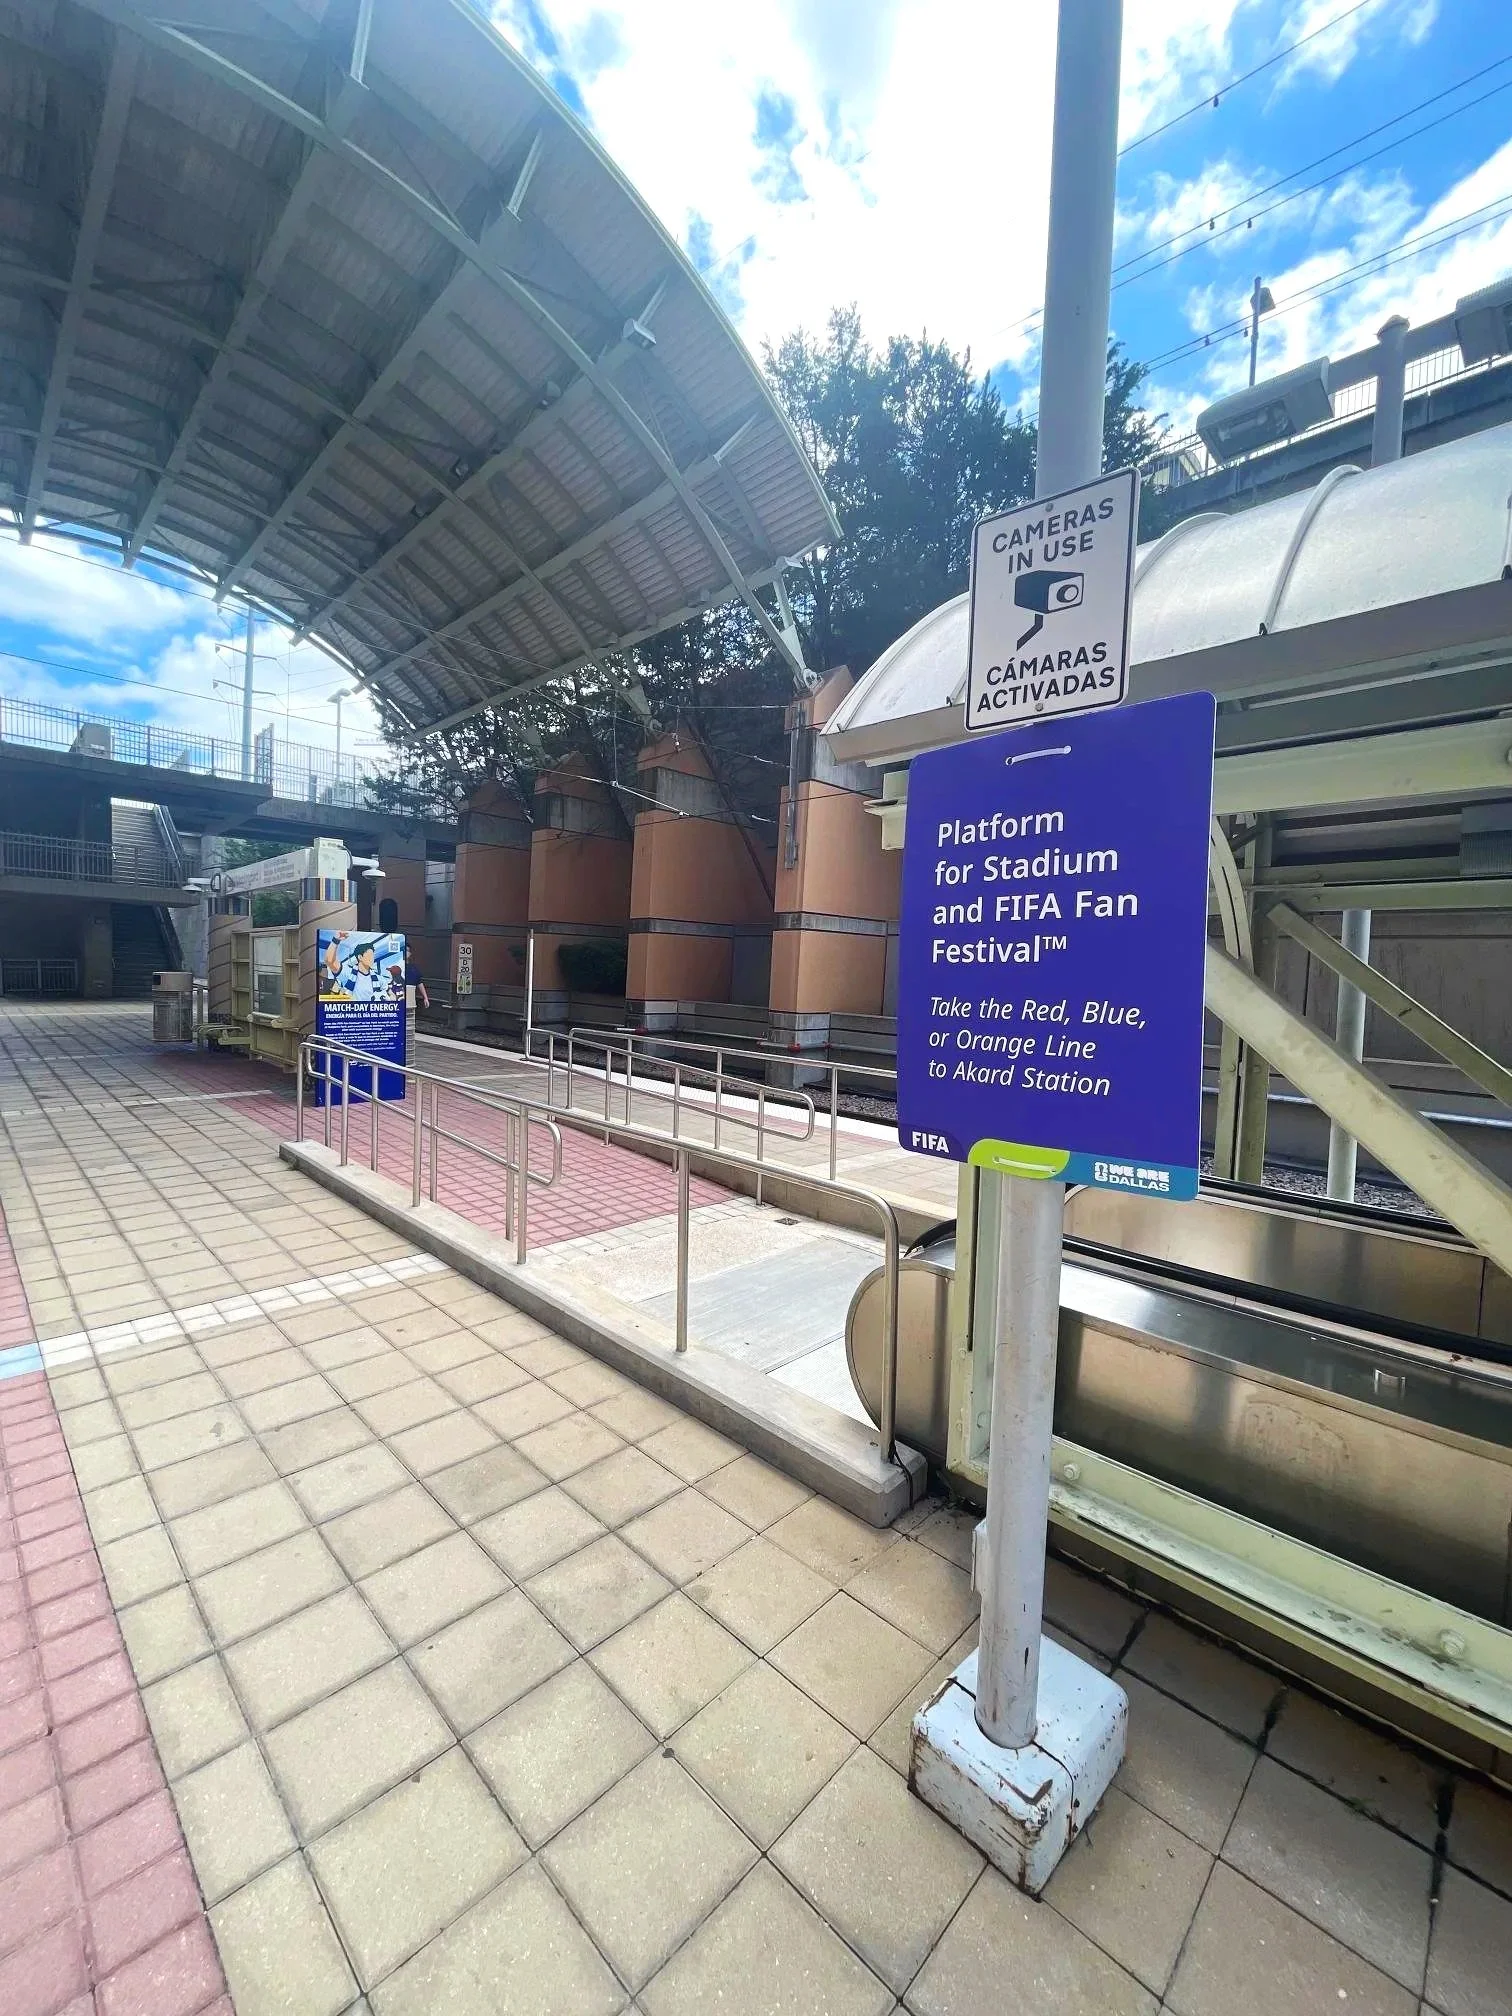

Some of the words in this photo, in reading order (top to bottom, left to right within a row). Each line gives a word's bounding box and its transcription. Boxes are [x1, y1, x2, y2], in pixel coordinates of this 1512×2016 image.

[992, 497, 1114, 553] CAMERAS
[1008, 548, 1033, 574] IN
[1043, 529, 1094, 563] USE
[986, 641, 1107, 686] CÁMARAS
[977, 666, 1116, 713] ACTIVADAS
[938, 810, 1064, 847] Platform
[935, 860, 974, 886] for
[983, 847, 1118, 882] Stadium
[933, 896, 983, 925] and
[995, 892, 1062, 922] FIFA
[1076, 890, 1138, 918] Fan
[932, 935, 1067, 964] Festival™
[930, 997, 972, 1018] Take
[979, 997, 1013, 1020] the
[1021, 999, 1070, 1026] Red,
[1081, 1000, 1147, 1030] Blue,
[929, 1031, 949, 1047] or
[956, 1029, 1036, 1059] Orange
[1045, 1034, 1096, 1059] Line
[928, 1058, 947, 1078] to
[953, 1060, 1015, 1086] Akard
[1022, 1067, 1110, 1096] Station
[912, 1131, 949, 1153] FIFA
[1109, 1163, 1135, 1178] WE
[1136, 1168, 1170, 1183] ARE
[1109, 1174, 1170, 1193] DALLAS
